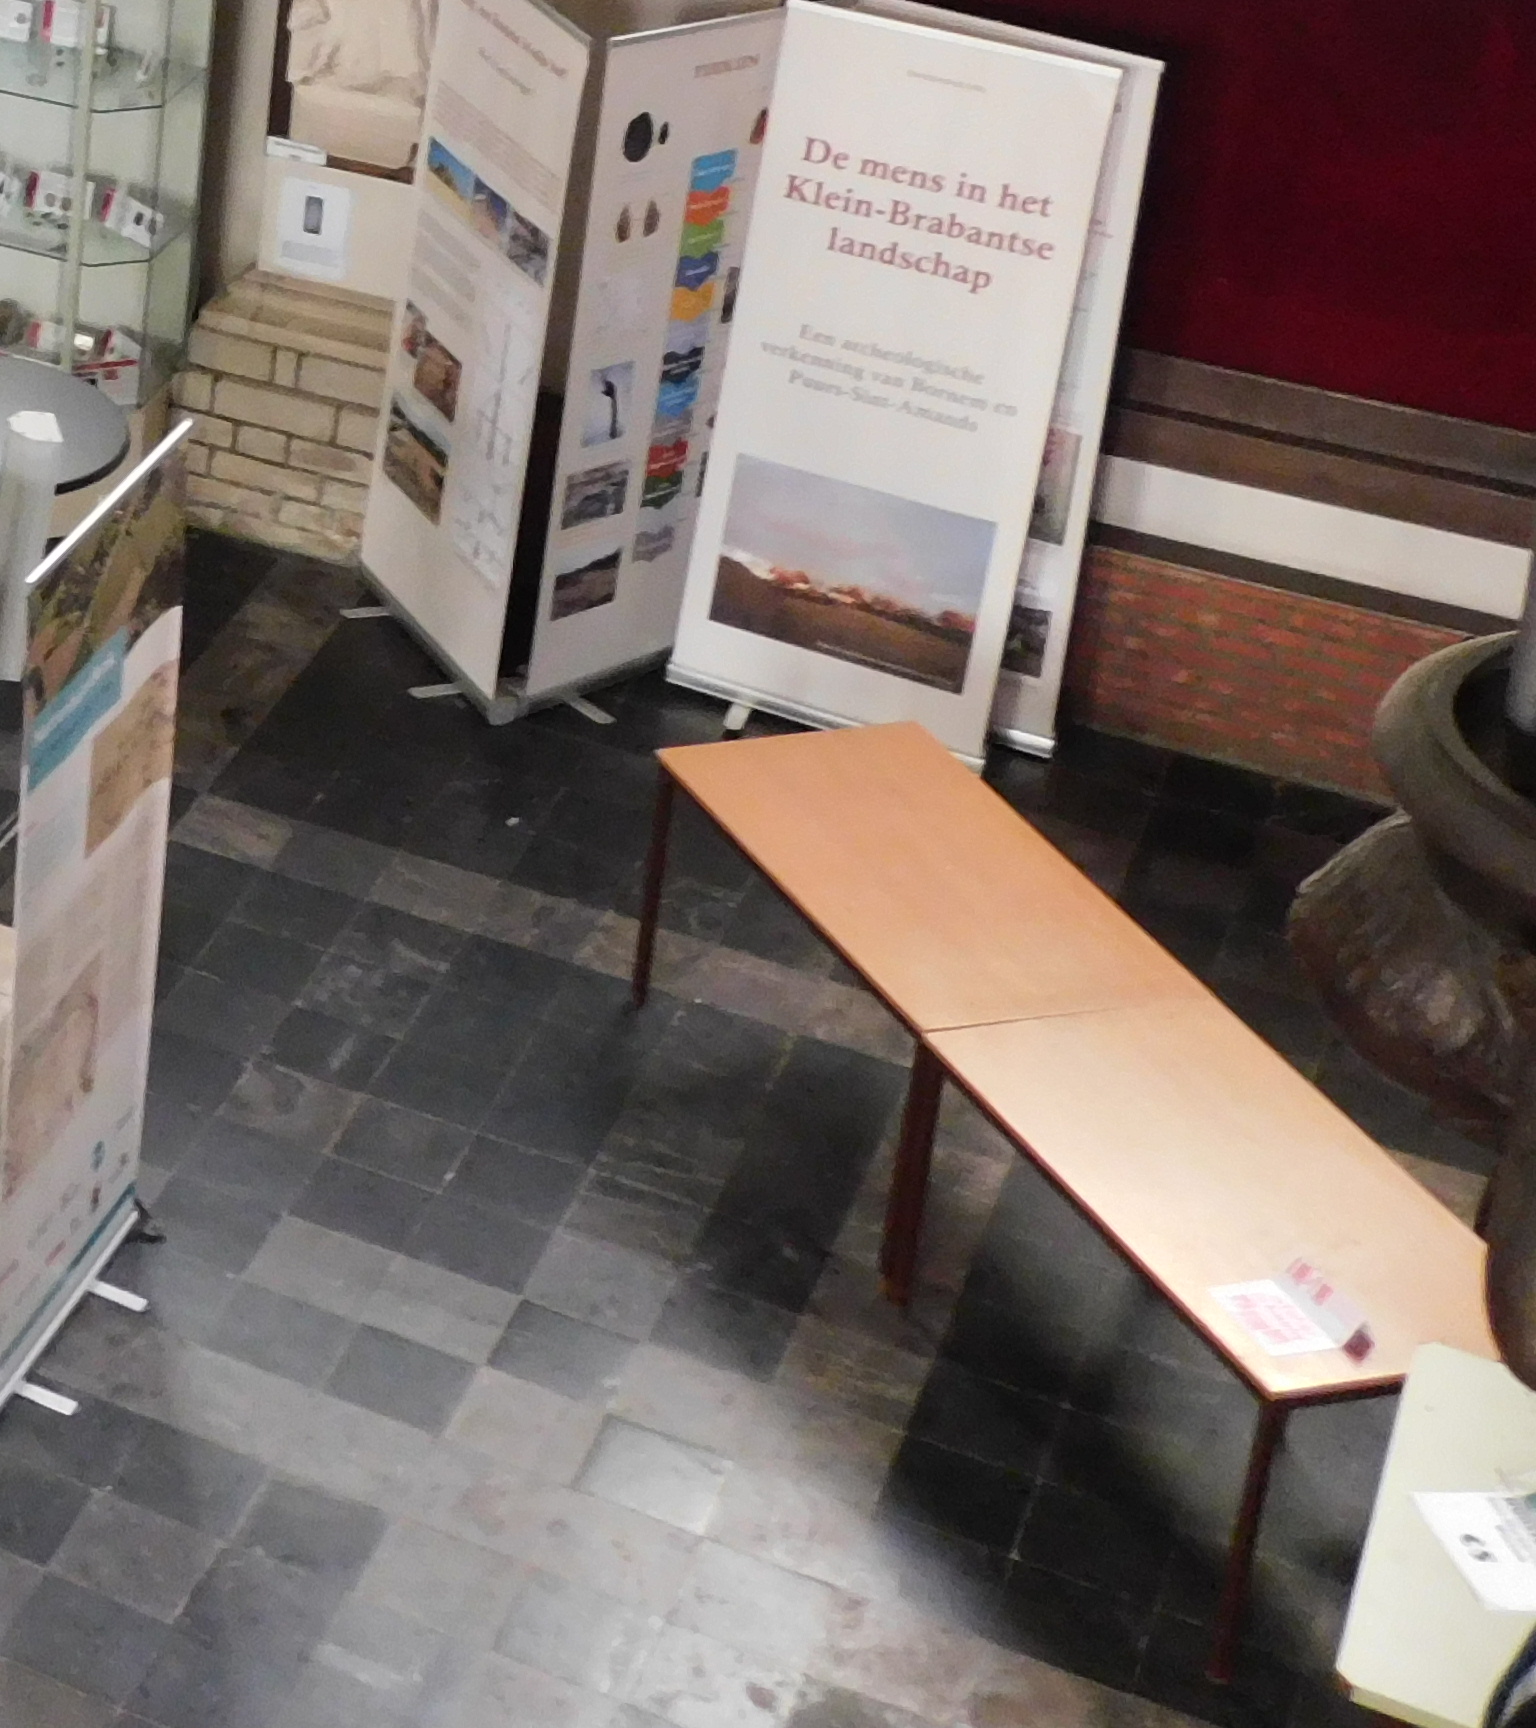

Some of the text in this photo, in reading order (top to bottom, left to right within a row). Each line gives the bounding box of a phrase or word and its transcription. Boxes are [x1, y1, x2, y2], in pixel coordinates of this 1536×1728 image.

[802, 137, 1052, 218] De mens in het
[784, 174, 1054, 260] Klein-Brabantse
[827, 227, 991, 294] landschap
[799, 324, 836, 346] Een
